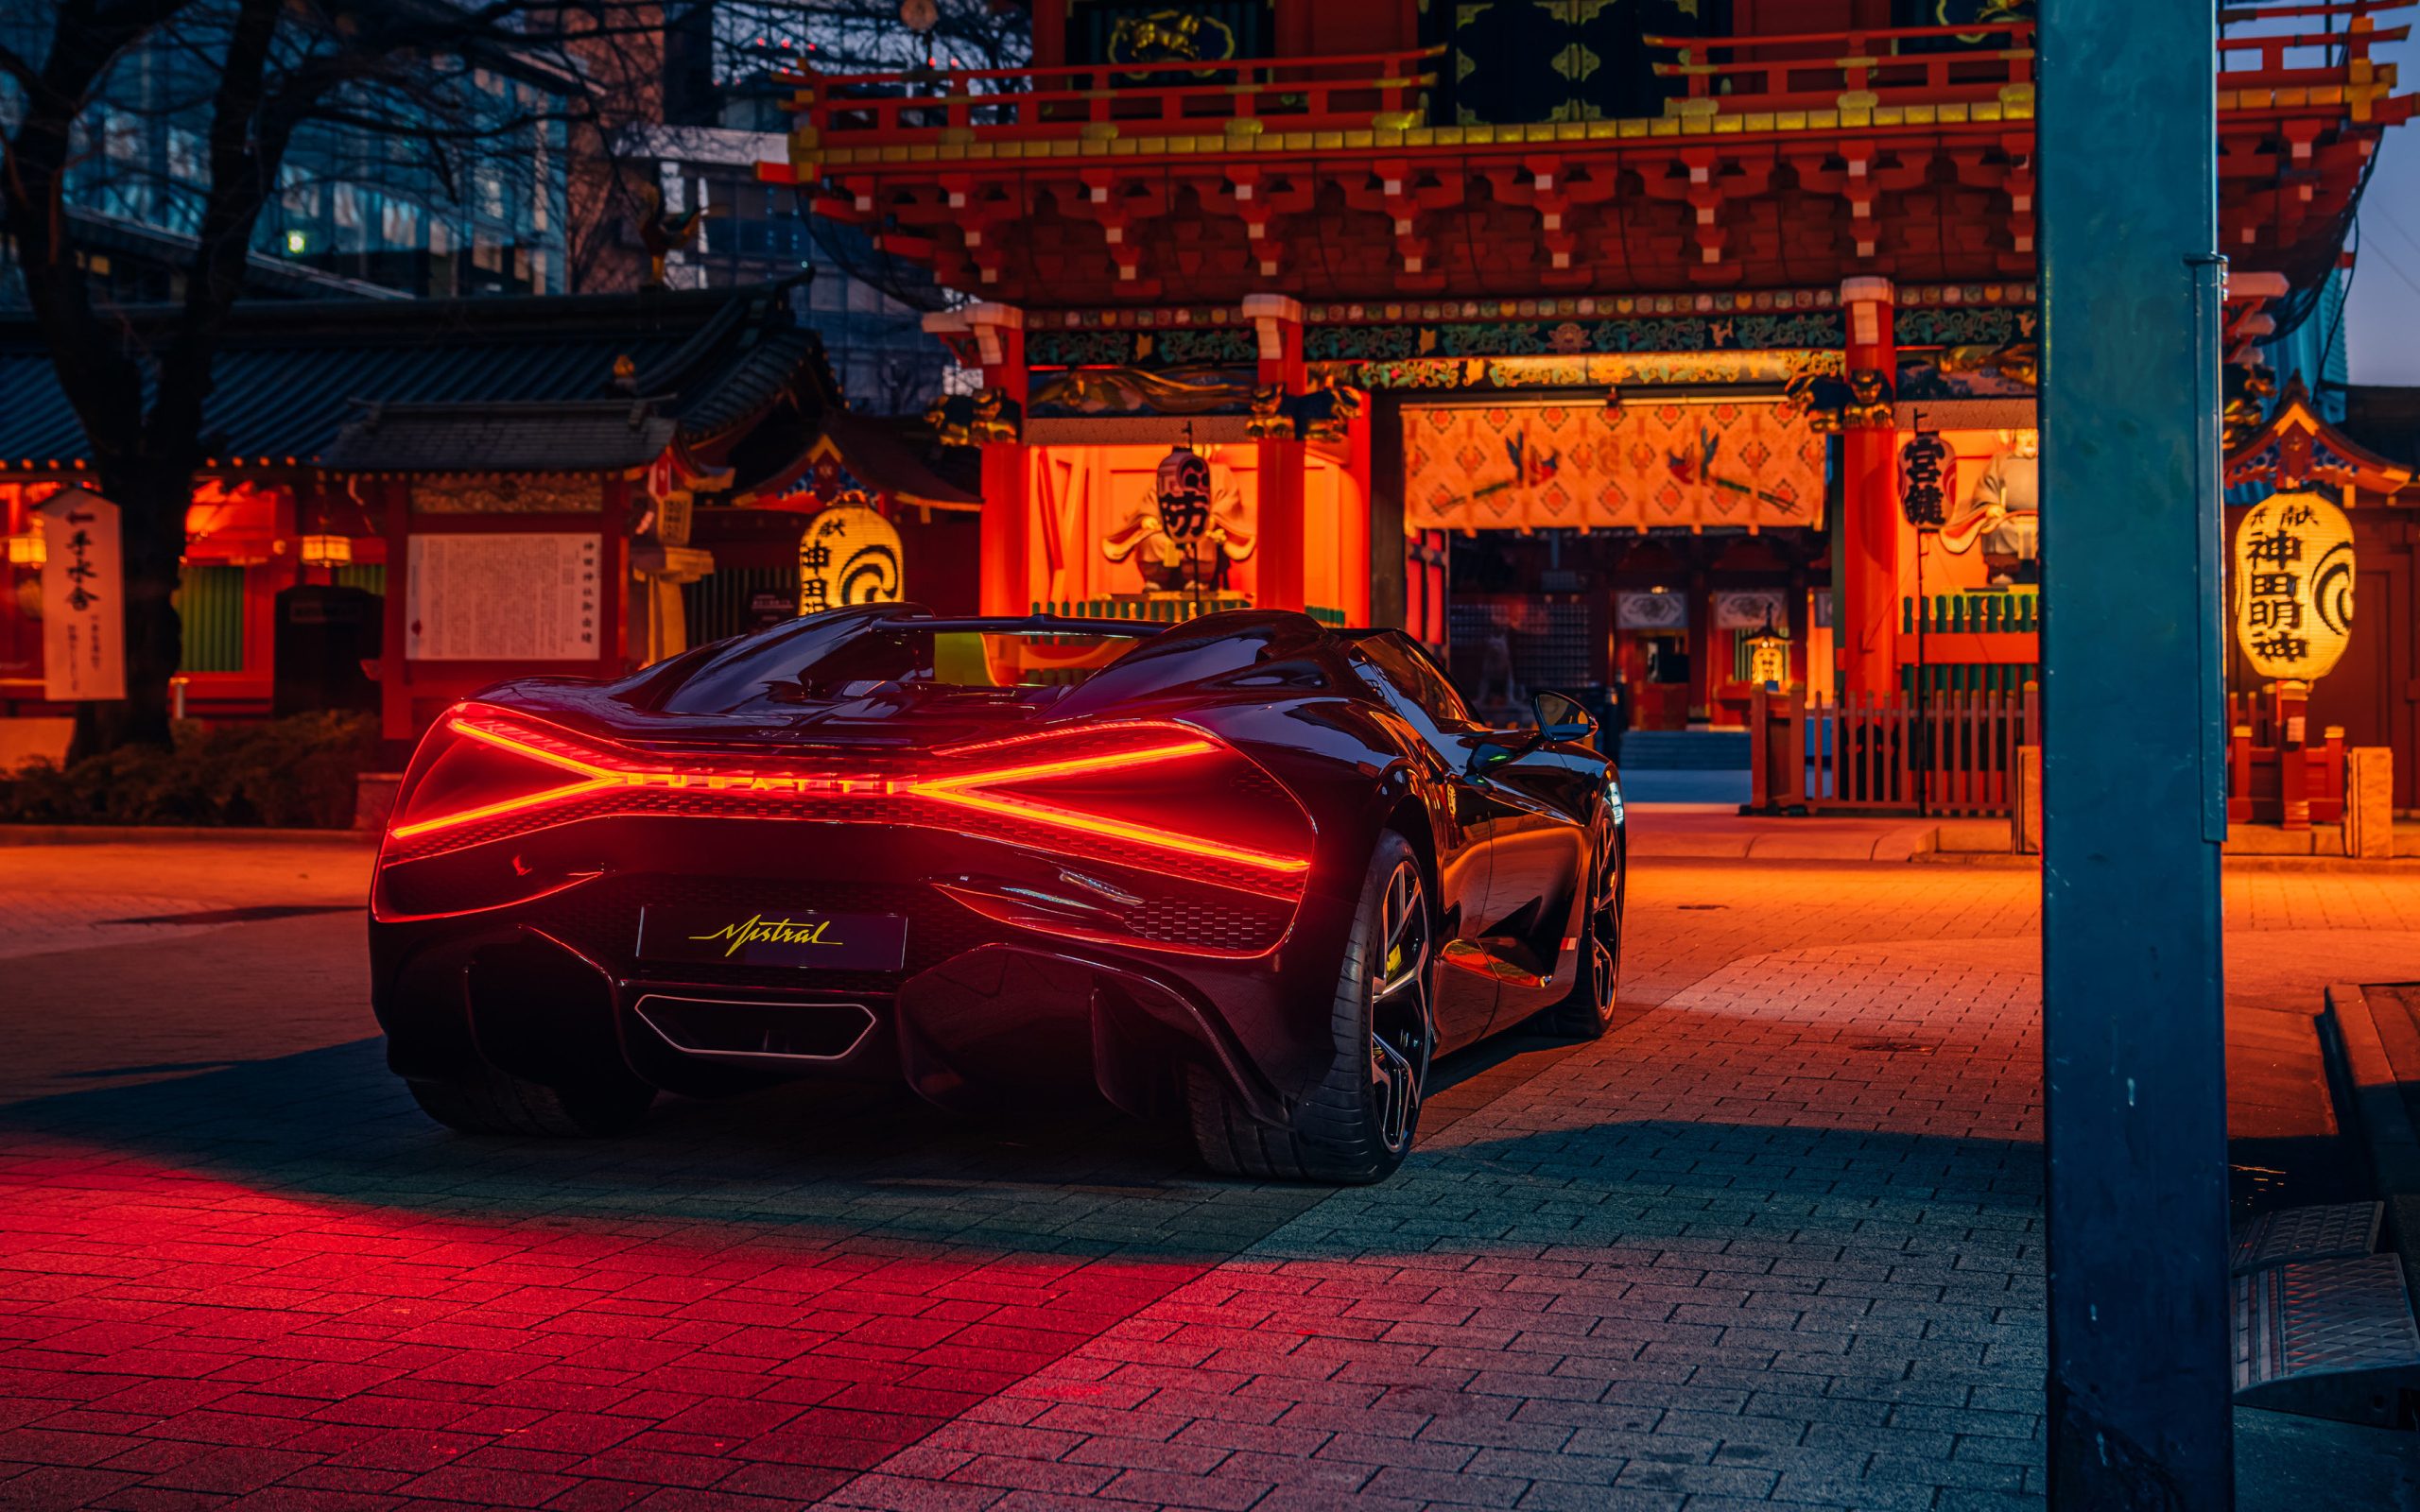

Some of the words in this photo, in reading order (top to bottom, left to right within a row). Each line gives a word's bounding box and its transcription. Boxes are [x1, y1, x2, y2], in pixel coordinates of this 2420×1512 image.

[2246, 529, 2309, 662] 神田明神
[688, 914, 843, 957] Mistral
